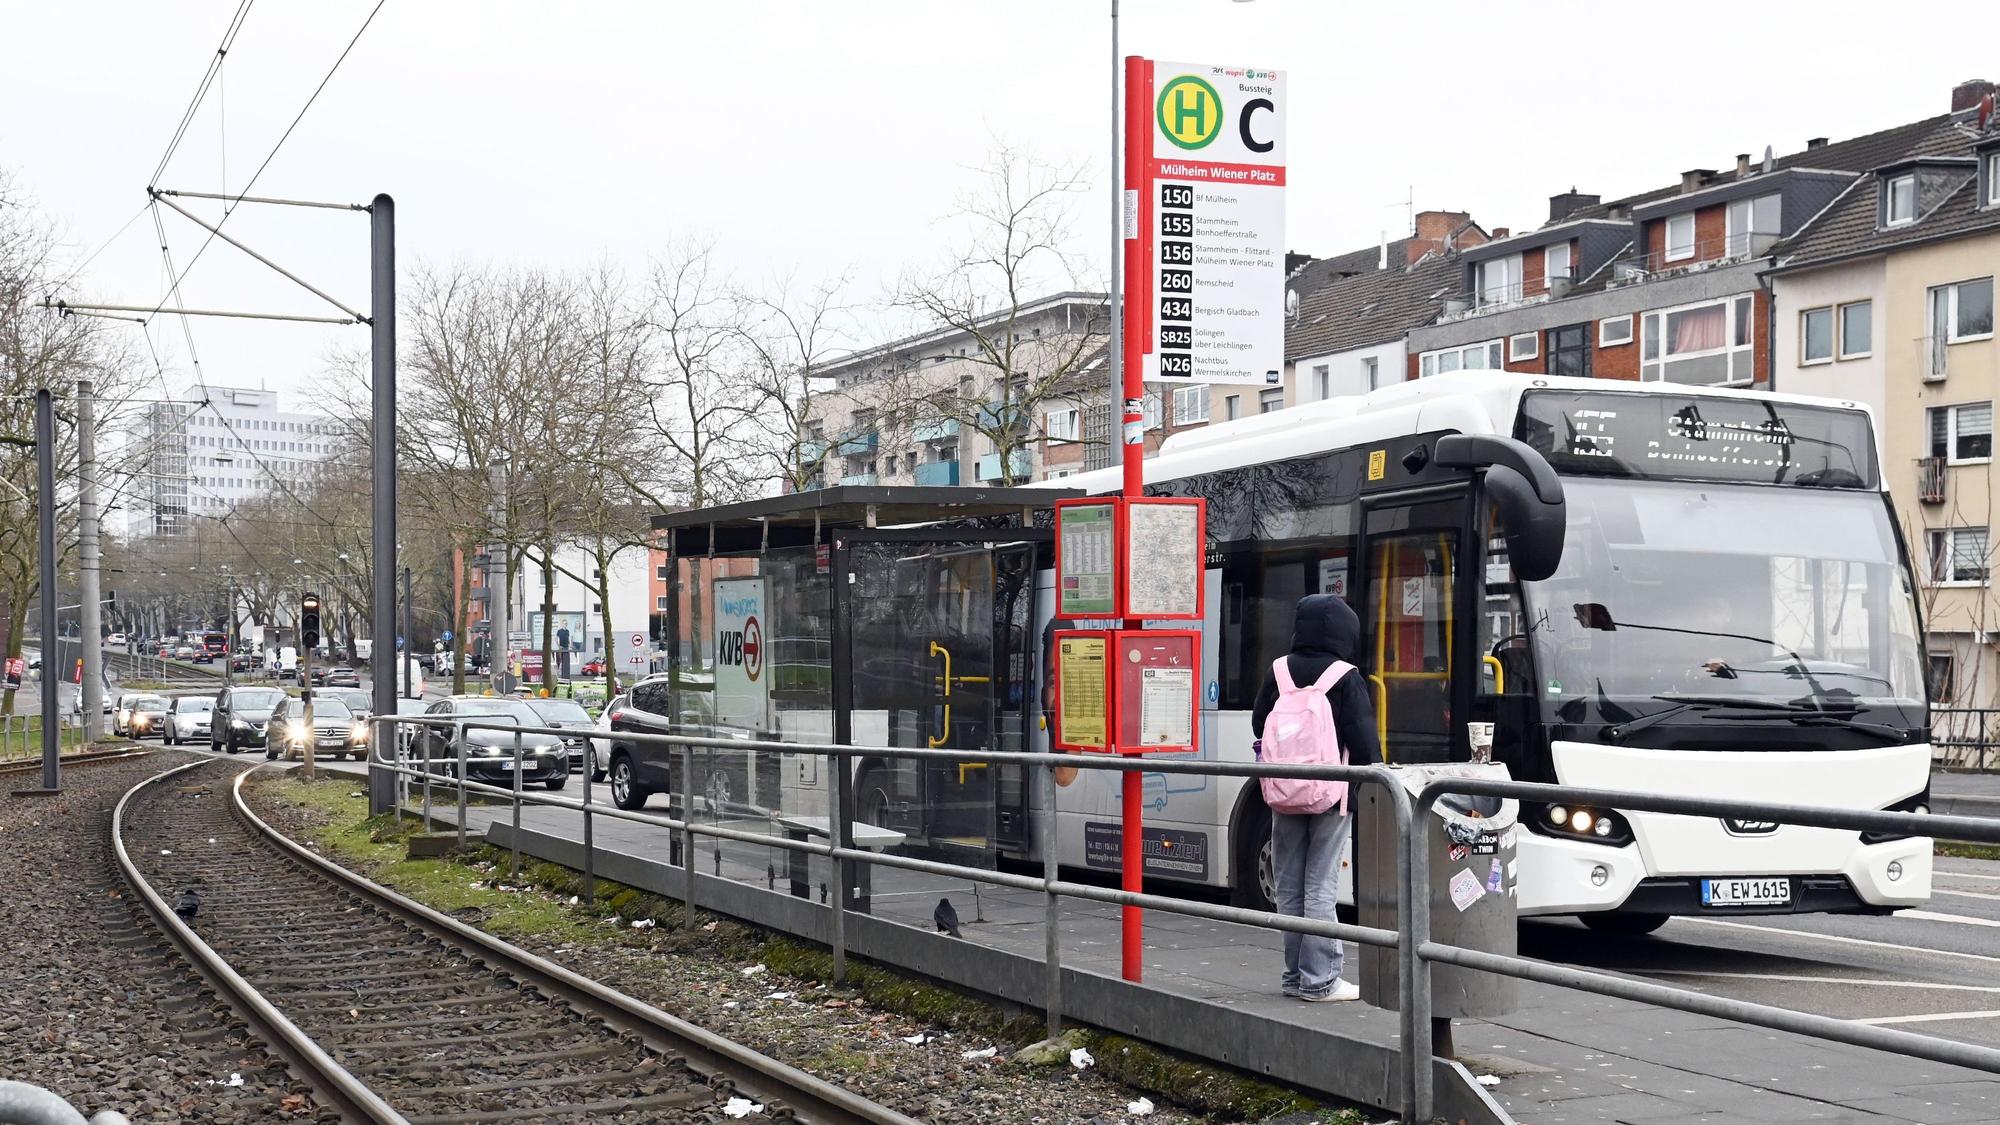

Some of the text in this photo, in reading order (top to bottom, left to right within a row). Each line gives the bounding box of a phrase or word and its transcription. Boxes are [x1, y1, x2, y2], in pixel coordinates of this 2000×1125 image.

[1239, 84, 1272, 95] Bussteig
[1175, 90, 1204, 136] H
[1239, 98, 1274, 153] C
[1161, 164, 1276, 182] Mülheim Wiener Platz
[1163, 189, 1192, 205] 150
[1196, 194, 1238, 204] Bf Mülheim
[1163, 217, 1192, 233] 155
[1196, 217, 1239, 226] Stammheim
[1196, 229, 1258, 240] Bonhoefferstraße
[1163, 245, 1191, 261] 156
[1196, 245, 1239, 254] Stammheim
[1245, 247, 1270, 256] Flittard
[1196, 256, 1274, 268] Mülheim Wiener Platz
[1162, 274, 1191, 289] 260
[1196, 278, 1234, 288] Remscheid
[1162, 302, 1190, 317] 434
[1195, 306, 1260, 316] Bergisch Gladbach
[1161, 331, 1191, 344] SB25
[1195, 329, 1225, 338] Solingen
[1195, 340, 1253, 350] über Leichlingen
[1161, 358, 1190, 372] N26
[1195, 356, 1228, 365] Nachtbus
[1195, 368, 1252, 377] Wermelskirchen
[720, 631, 742, 666] KVB
[1712, 882, 1788, 899] K EW 1615
